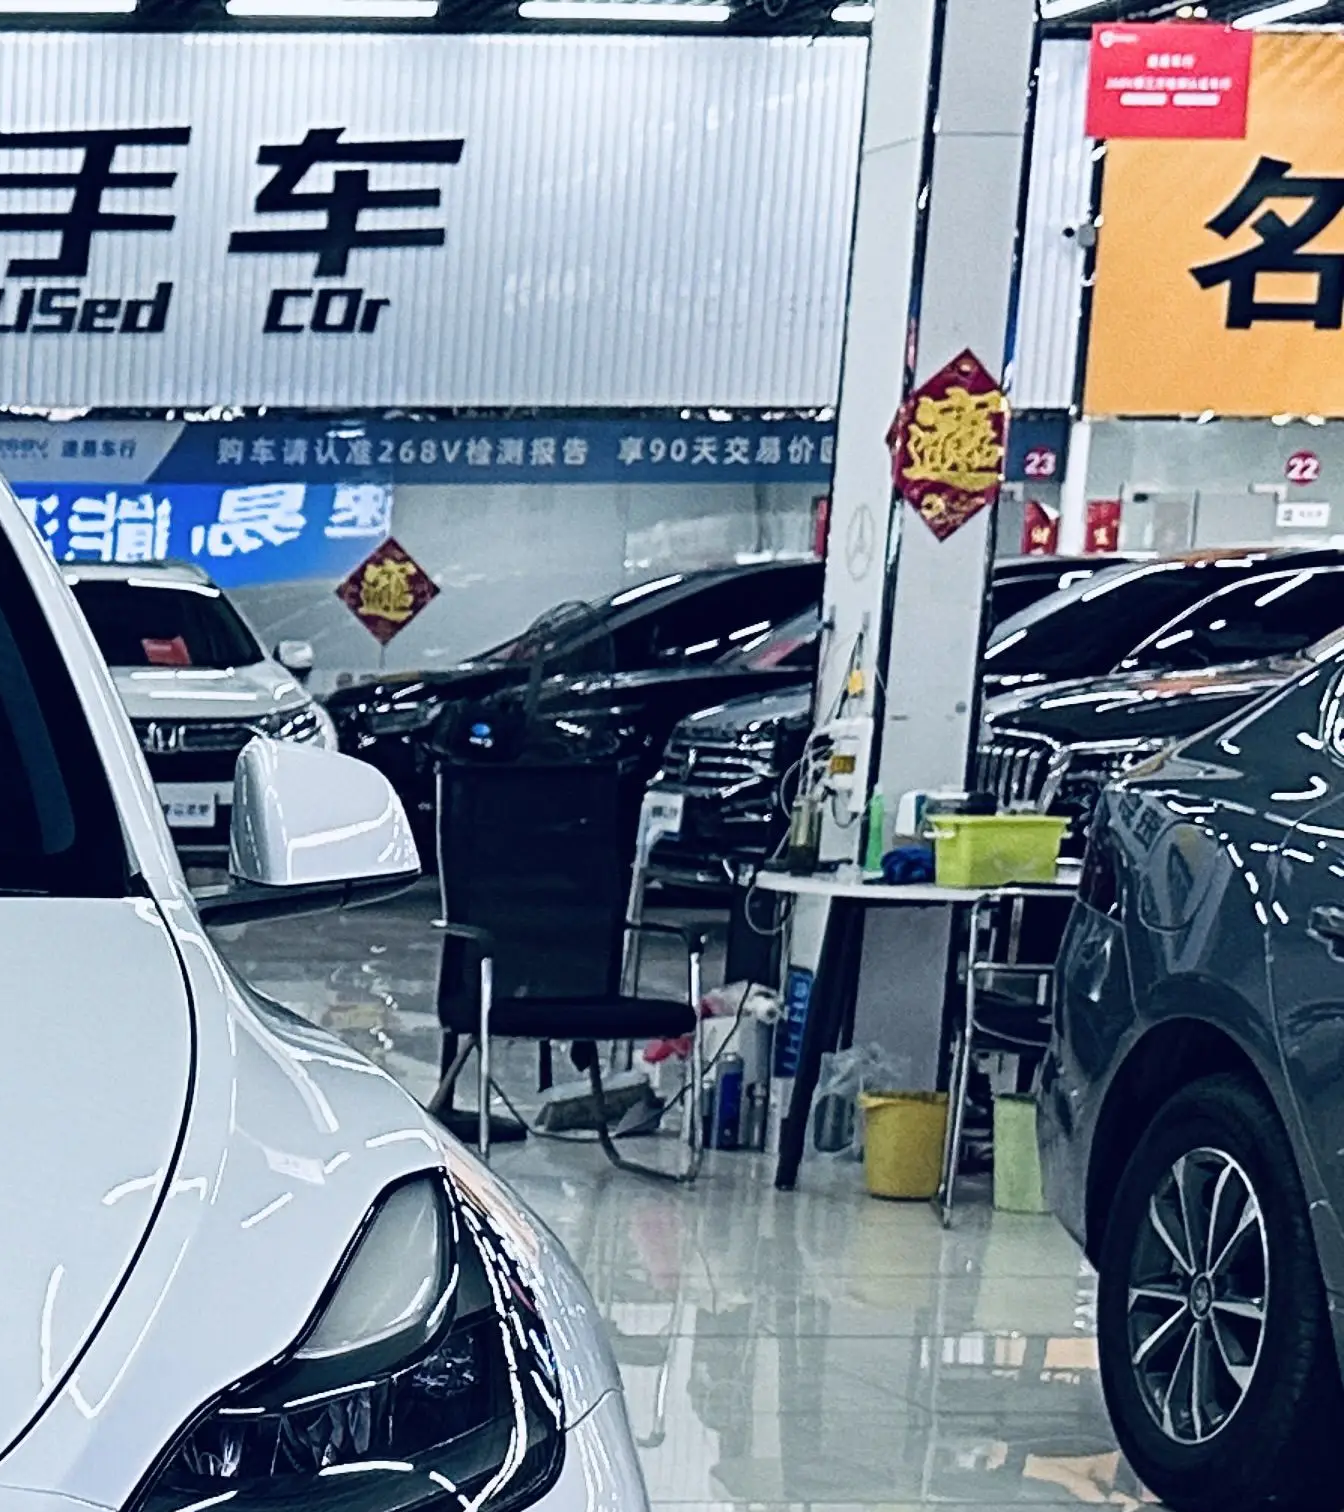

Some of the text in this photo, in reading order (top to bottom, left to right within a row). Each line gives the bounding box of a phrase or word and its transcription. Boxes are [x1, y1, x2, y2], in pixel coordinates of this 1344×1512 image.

[1188, 155, 1344, 331] 名
[216, 437, 589, 467] 购车请认准268V检测报告
[1024, 452, 1056, 475] 23
[1286, 458, 1320, 480] 22
